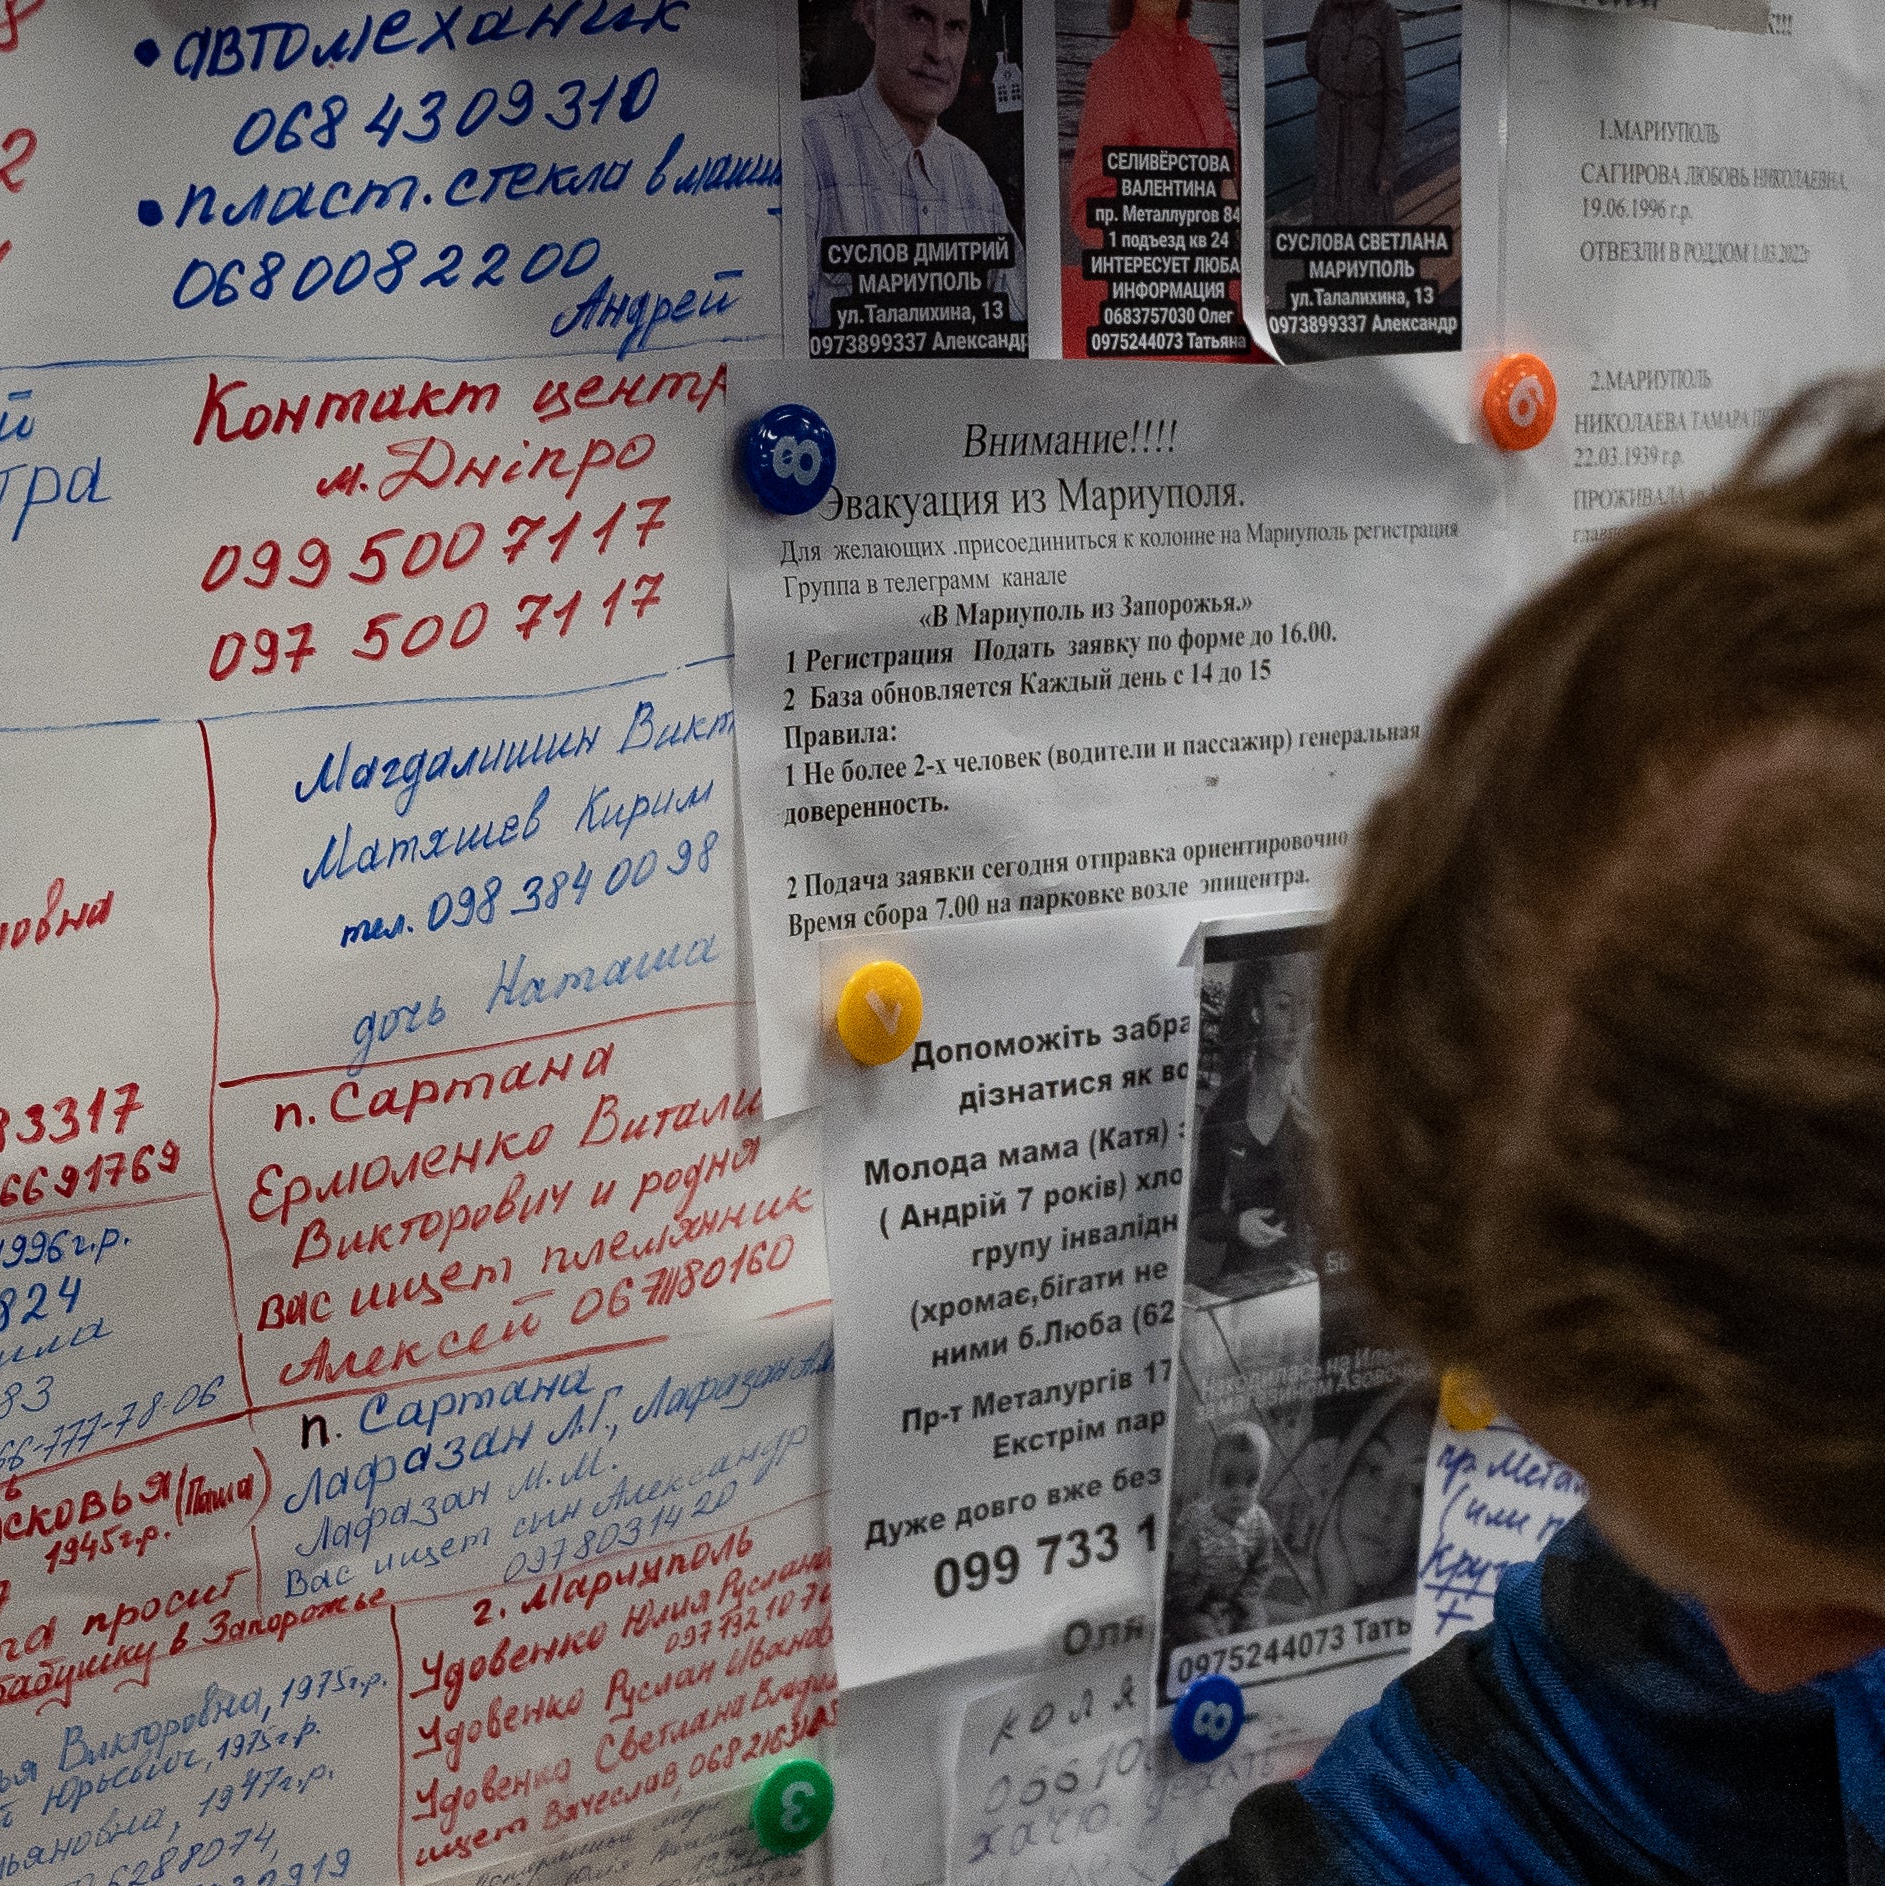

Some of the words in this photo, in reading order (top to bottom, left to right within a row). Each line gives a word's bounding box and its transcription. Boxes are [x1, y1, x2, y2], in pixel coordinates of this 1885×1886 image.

[1107, 150, 1230, 174] СЕЛИВЁРСТОВА
[1581, 163, 1680, 186] САГИРОВА
[1122, 178, 1215, 199] ВАЛЕНТИНА
[1122, 203, 1216, 226] Металлургов
[828, 241, 909, 266] СУСЛОВ
[913, 234, 1009, 265] ДМИТРИЙ
[1122, 231, 1185, 251] подъезд
[1189, 234, 1206, 248] кв
[1210, 231, 1229, 248] 24
[1276, 230, 1354, 253] СУСЛОВА
[1359, 230, 1448, 252] СВЕТЛАНА
[1580, 240, 1666, 264] ОТВЕЗЛИ
[859, 270, 982, 294] МАРИУПОЛЬ
[1092, 255, 1188, 275] ИНТЕРЕСУЕТ
[1309, 258, 1414, 279] МАРИУПОЛЬ
[1112, 279, 1224, 301] ИНФОРМАЦИЯ
[1415, 285, 1434, 305] 13
[549, 269, 745, 360] Андрей
[980, 300, 1004, 321] 13
[1104, 305, 1195, 325] 0683757030
[1199, 304, 1234, 324] Олег
[1270, 314, 1366, 336] 0973899337
[1372, 311, 1457, 338] Александр
[810, 332, 926, 355] 0973899337
[1092, 330, 1183, 351] 0975244073
[1186, 330, 1246, 351] Татьяна
[194, 372, 498, 445] Контакт
[1574, 411, 1686, 435] НИКОЛАЕВА
[964, 419, 1179, 460] Внимание!!!!
[1011, 485, 1047, 515] из
[1058, 475, 1245, 519] Мариуполя.
[780, 538, 822, 566] Для
[834, 536, 945, 564] желающих
[784, 572, 861, 604] Группа
[884, 569, 989, 598] телеграмм
[1002, 564, 1067, 589] канале
[956, 599, 1084, 631] Мариуполь
[1090, 599, 1114, 621] из
[806, 641, 953, 674] Регистрация
[973, 638, 1055, 665] Подать
[1067, 631, 1140, 661] заявку
[1146, 632, 1172, 655] по
[1176, 626, 1246, 658] форме
[1253, 622, 1274, 648] до
[1280, 620, 1338, 646] 16.00.
[811, 683, 864, 710] База
[870, 672, 1013, 709] обновляется
[1019, 665, 1111, 700] Каждый
[1118, 664, 1167, 694] день
[784, 721, 897, 754] Правила:
[803, 759, 834, 786] Не
[841, 752, 906, 784] более
[914, 750, 946, 778] 2-х
[953, 742, 1041, 778] человек
[784, 791, 949, 829] доверенность.
[349, 995, 447, 1077] дочь
[487, 933, 719, 1013] Наташа
[911, 1021, 1102, 1071] Допоможіть
[329, 1042, 614, 1125] Сартана
[959, 1071, 1113, 1115] дізнатися
[1122, 1064, 1153, 1089] як
[864, 1147, 987, 1186] Молода
[998, 1136, 1079, 1168] мама
[1089, 1119, 1169, 1162] (Катя)
[248, 1123, 553, 1225] Ермоленко
[292, 1162, 573, 1270] Викторович
[900, 1189, 1006, 1232] Андрій
[1043, 1166, 1125, 1216] років)
[972, 1231, 1052, 1270] групу
[350, 1255, 511, 1318] ищет
[278, 1290, 552, 1388] Алексей
[932, 1332, 1008, 1369] ними
[902, 1405, 961, 1436] Пр-т
[972, 1364, 1132, 1424] Металургів
[993, 1419, 1106, 1461] Екстрім
[864, 1505, 945, 1551] Дуже
[955, 1489, 1036, 1532] довго
[1045, 1477, 1103, 1511] вже
[1113, 1464, 1162, 1494] без
[521, 1525, 753, 1618] Мариуполь
[933, 1547, 1020, 1600] 099
[1036, 1522, 1120, 1576] 733
[82, 1567, 254, 1646] просит
[411, 1622, 609, 1709] Удовенко
[1176, 1625, 1345, 1686] 0975244073
